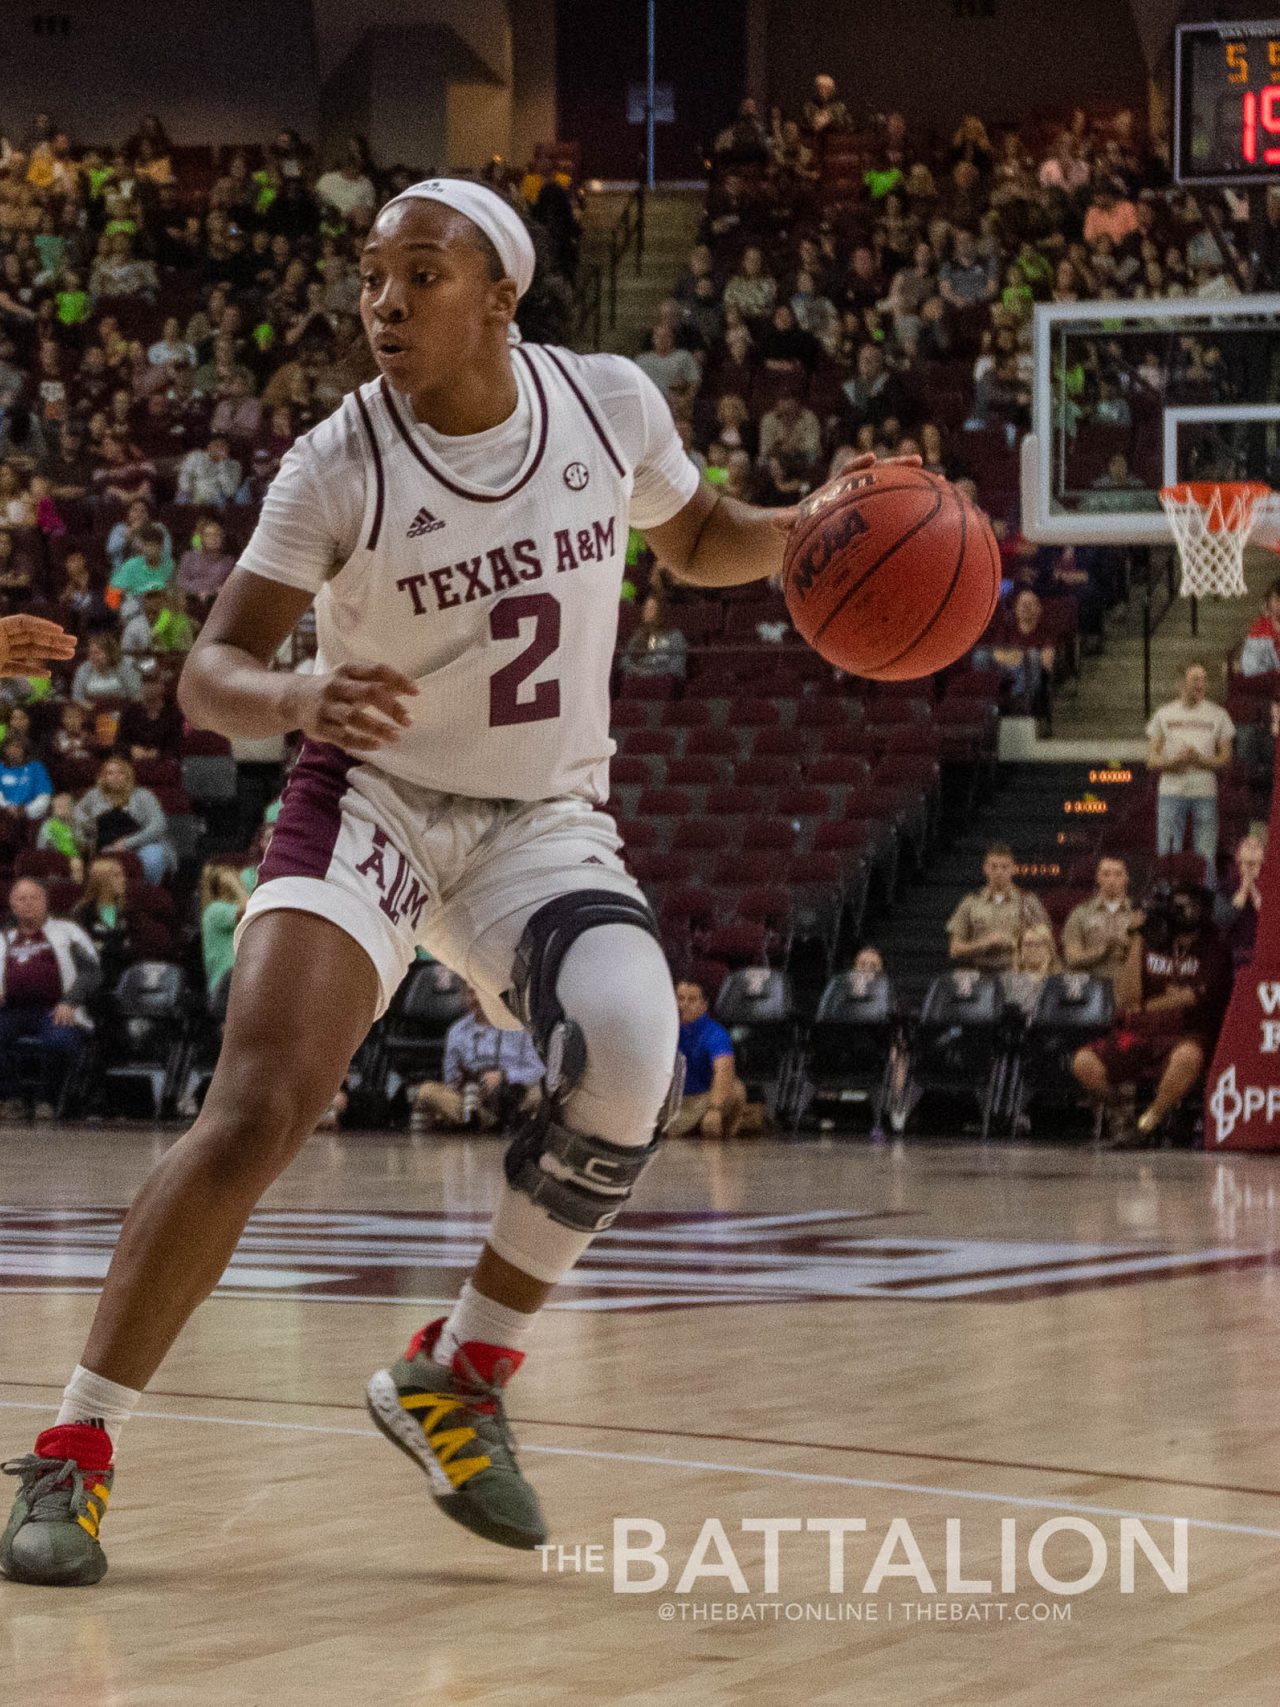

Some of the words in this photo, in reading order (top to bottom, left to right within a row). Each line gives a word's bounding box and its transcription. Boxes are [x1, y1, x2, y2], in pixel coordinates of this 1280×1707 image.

[396, 538, 544, 616] TEXAS
[553, 515, 617, 573] A&M
[406, 519, 446, 538] adidas
[488, 592, 562, 728] 2
